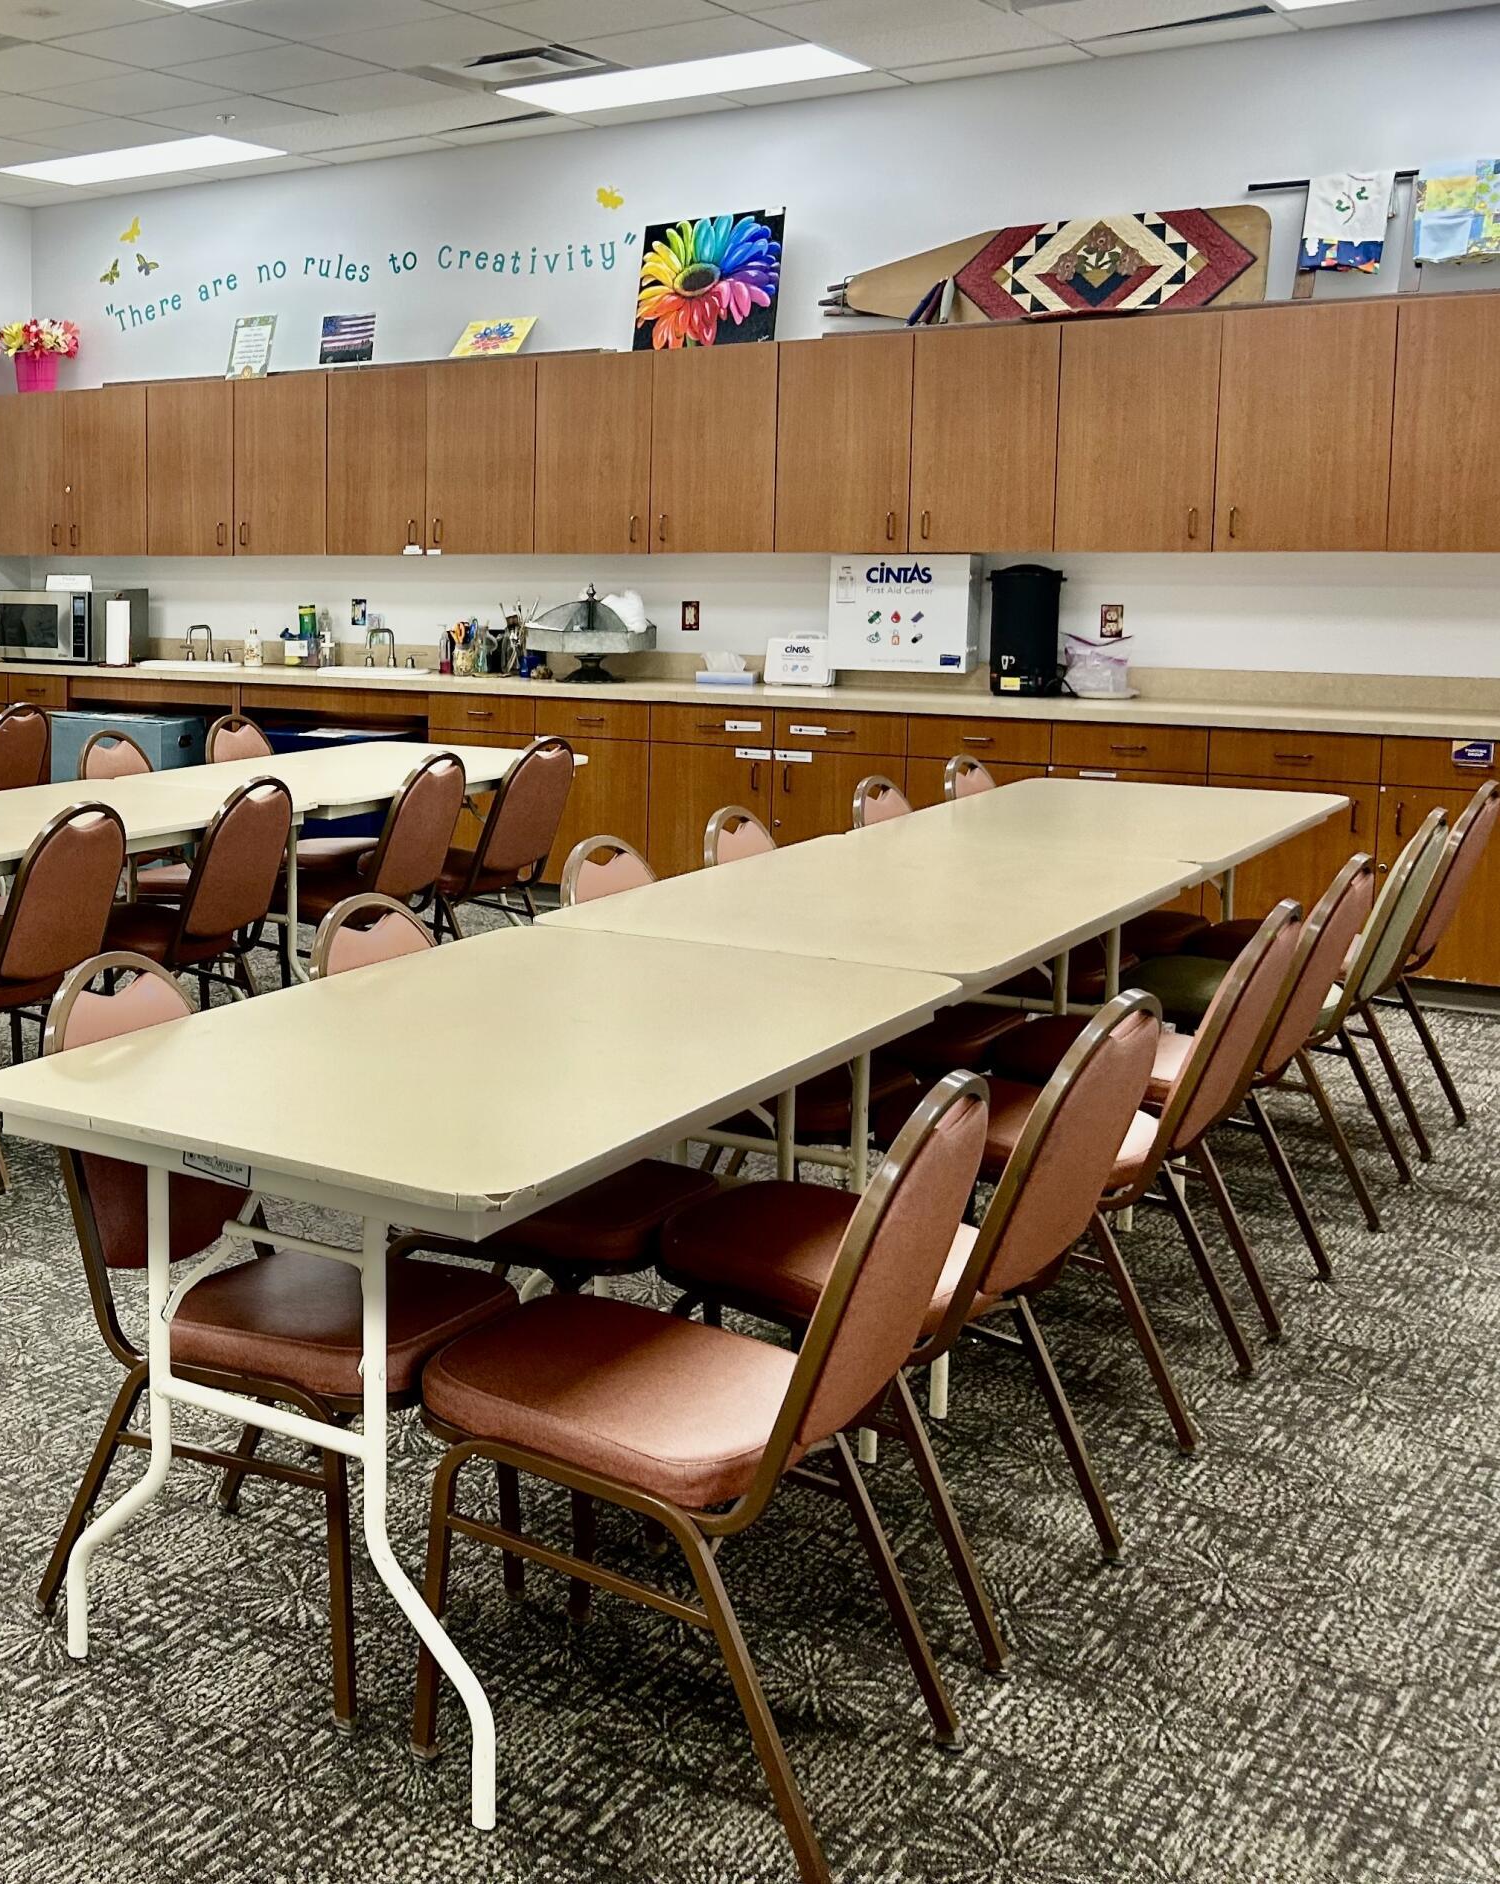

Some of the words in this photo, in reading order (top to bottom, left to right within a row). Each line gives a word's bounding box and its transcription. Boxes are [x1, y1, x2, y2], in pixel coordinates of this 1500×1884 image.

[198, 273, 238, 301] are
[256, 259, 287, 283] no
[303, 254, 371, 283] rules
[388, 250, 418, 274] to
[866, 586, 885, 594] First
[887, 586, 902, 594] Aid
[904, 586, 934, 595] Center
